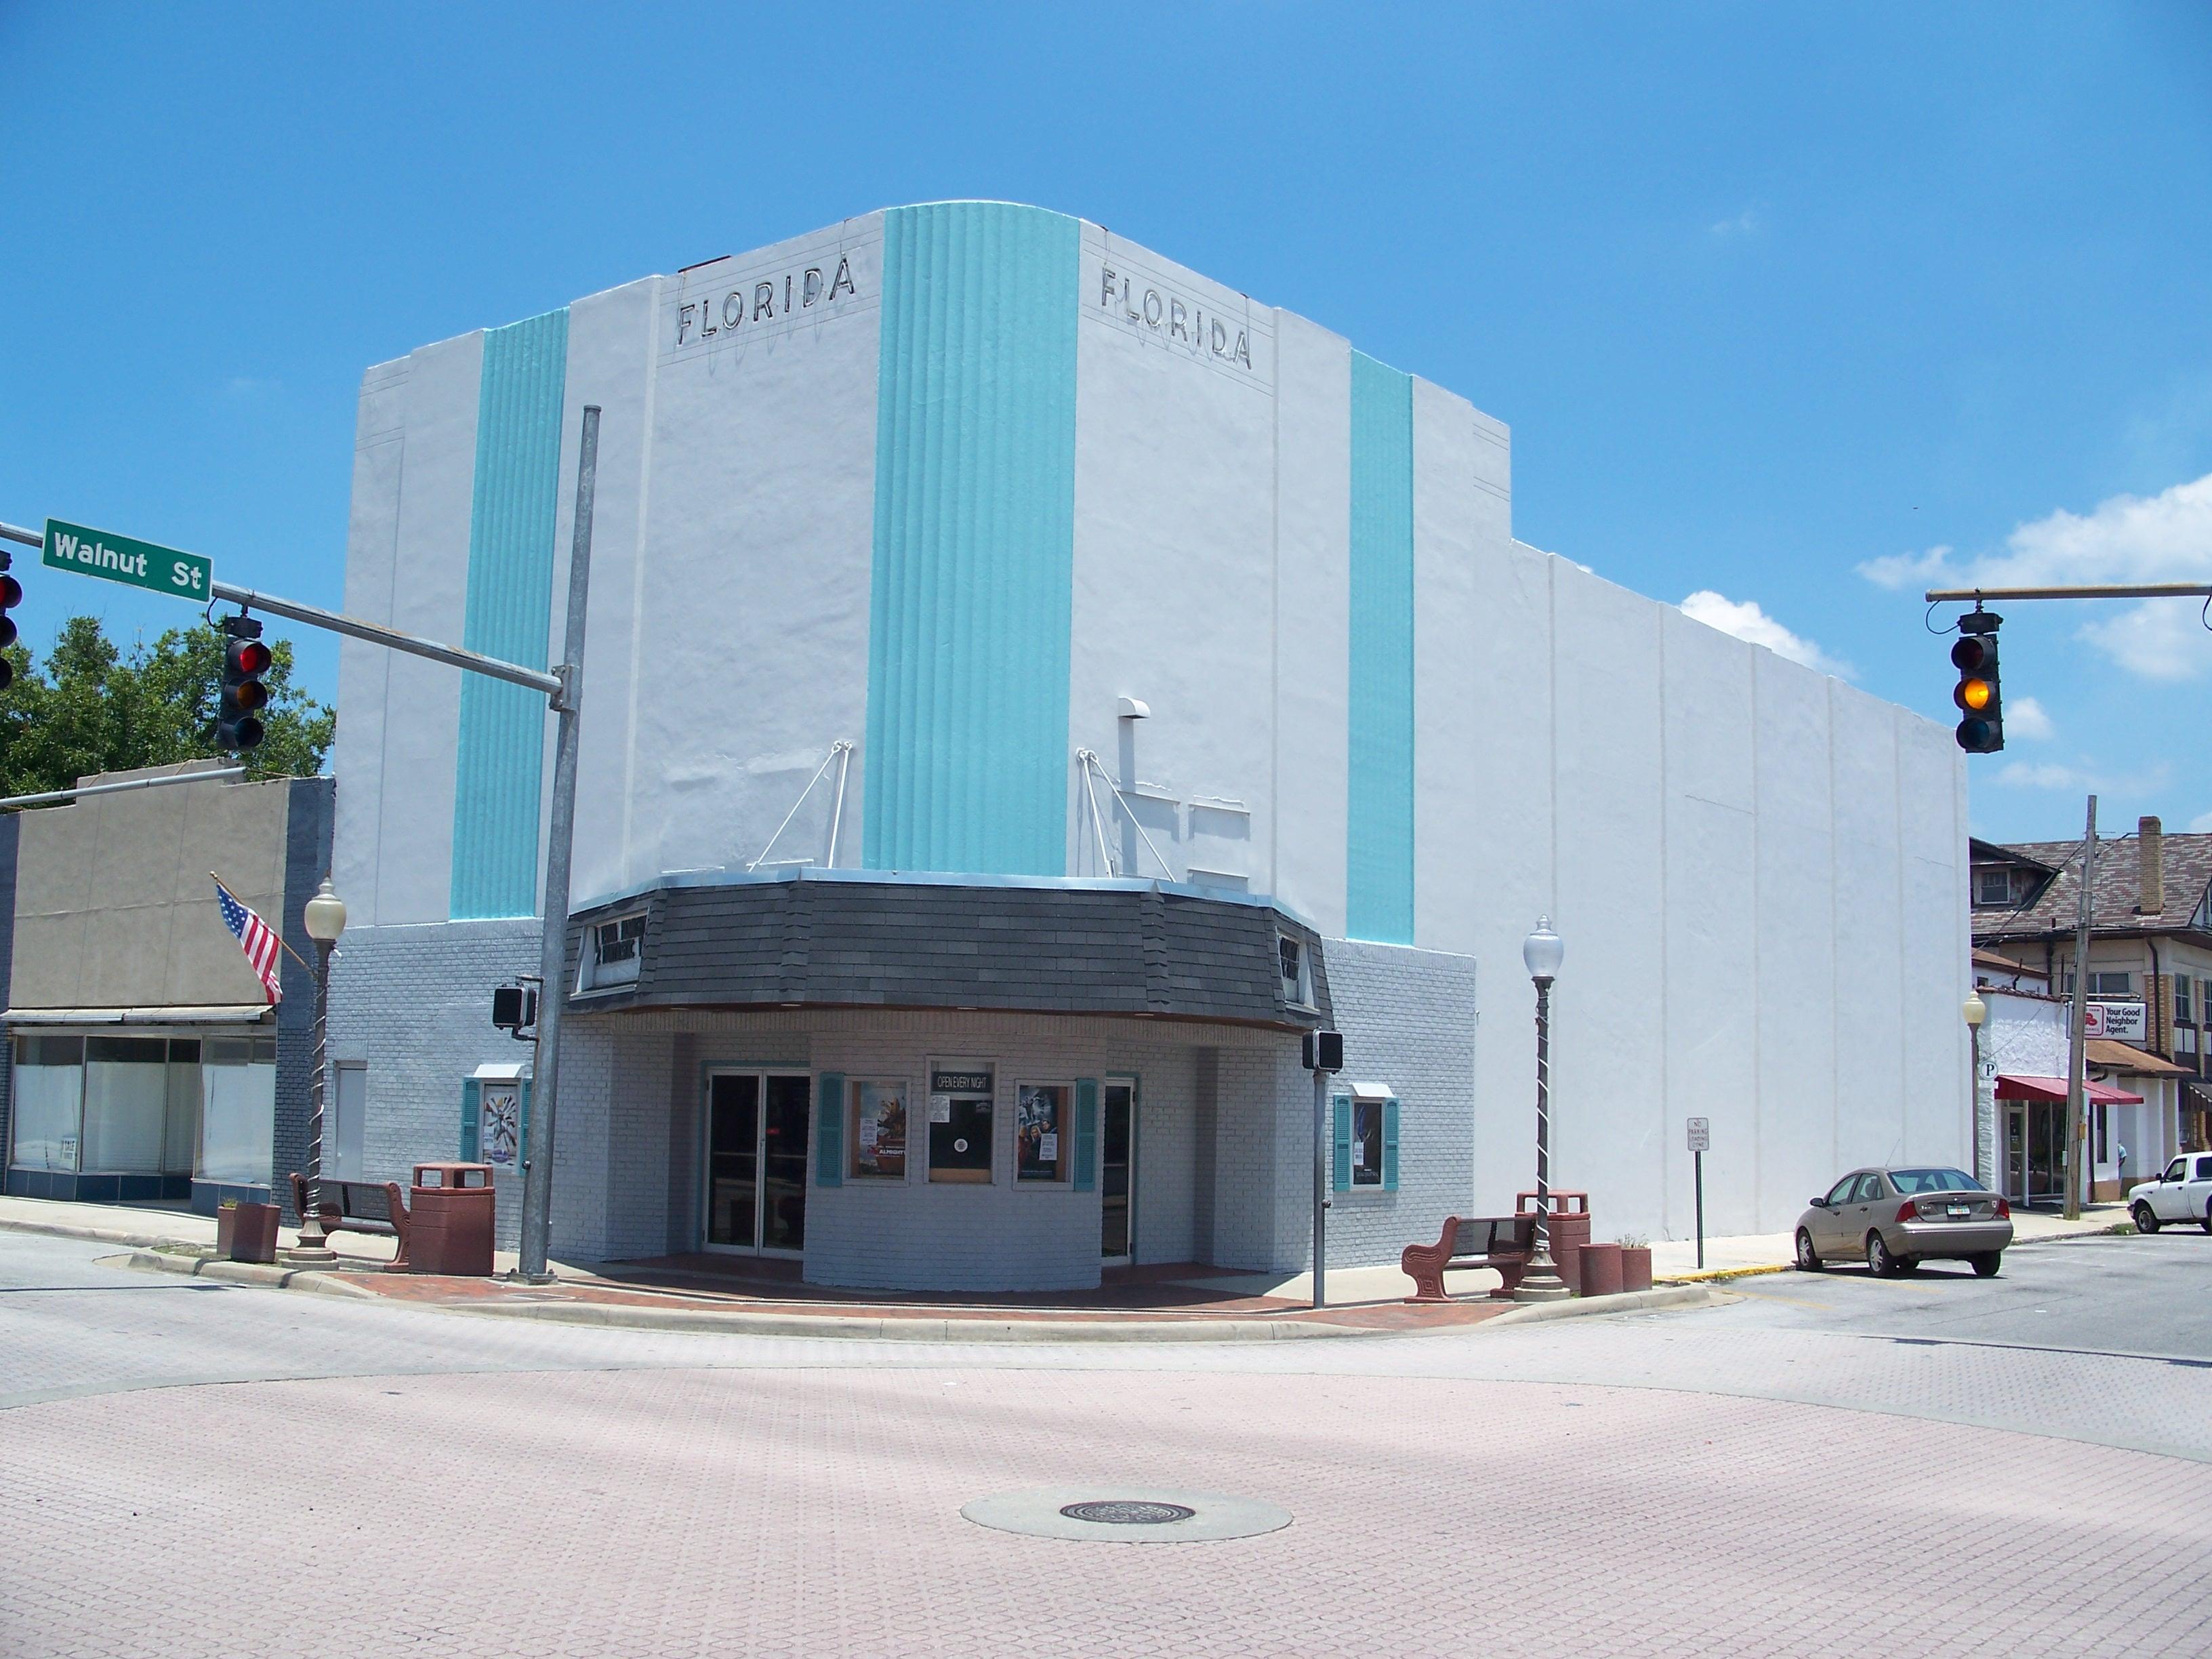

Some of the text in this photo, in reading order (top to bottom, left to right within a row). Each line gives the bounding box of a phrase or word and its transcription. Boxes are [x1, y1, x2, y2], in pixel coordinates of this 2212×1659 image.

[677, 258, 855, 346] FLORIDA
[1101, 266, 1252, 370] FLORIDA
[54, 531, 203, 590] Walnut St
[2106, 1007, 2140, 1017] Your Good
[2106, 1017, 2138, 1025] Neighbor
[2106, 1025, 2129, 1035] Agent.
[1986, 1063, 1994, 1076] P
[937, 1076, 987, 1089] OPEN EVERY NIGHT
